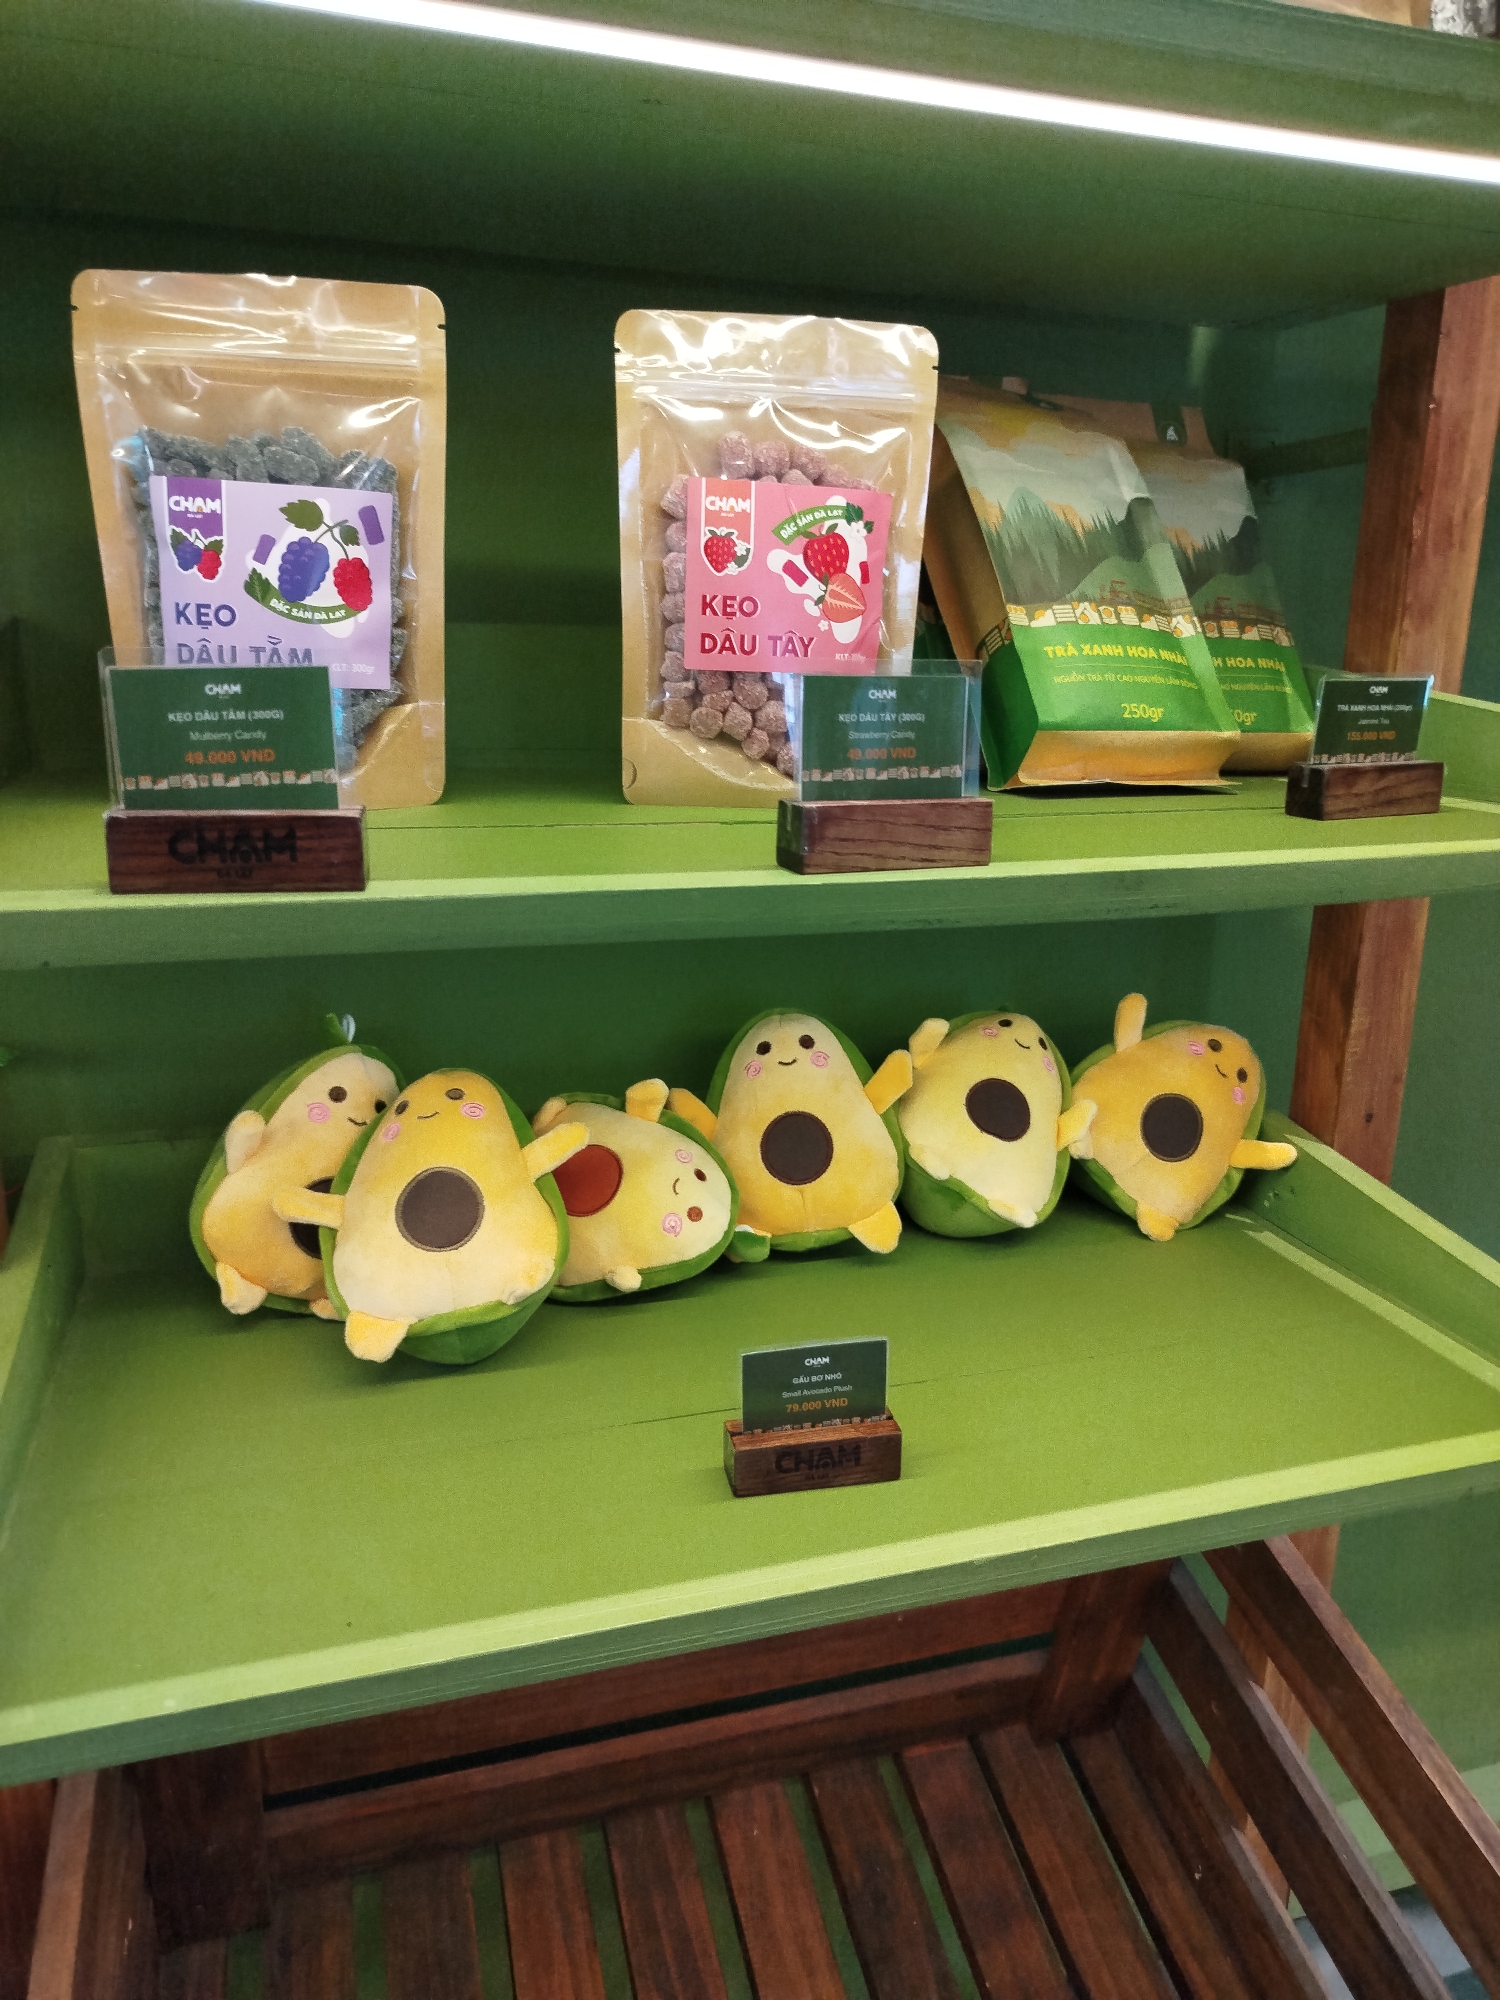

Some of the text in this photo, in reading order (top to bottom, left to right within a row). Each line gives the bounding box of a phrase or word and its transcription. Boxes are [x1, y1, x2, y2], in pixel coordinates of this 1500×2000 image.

[174, 602, 237, 629] KẸO
[701, 594, 761, 620] KẸO
[177, 635, 313, 666] DÂU TẰM
[700, 627, 818, 658] DÂU TÂY
[1044, 642, 1189, 667] TRÀ XANH HOA NHÀI
[1225, 657, 1255, 669] HOA
[1121, 703, 1164, 722] 250gr
[1233, 709, 1258, 726] 0gr
[241, 748, 276, 763] VND
[890, 746, 917, 760] VND
[792, 1374, 810, 1385] GẤU
[811, 1374, 824, 1383] BƠ
[782, 1384, 853, 1399] Small Avocado Plush
[785, 1397, 849, 1413] 79.000 VND
